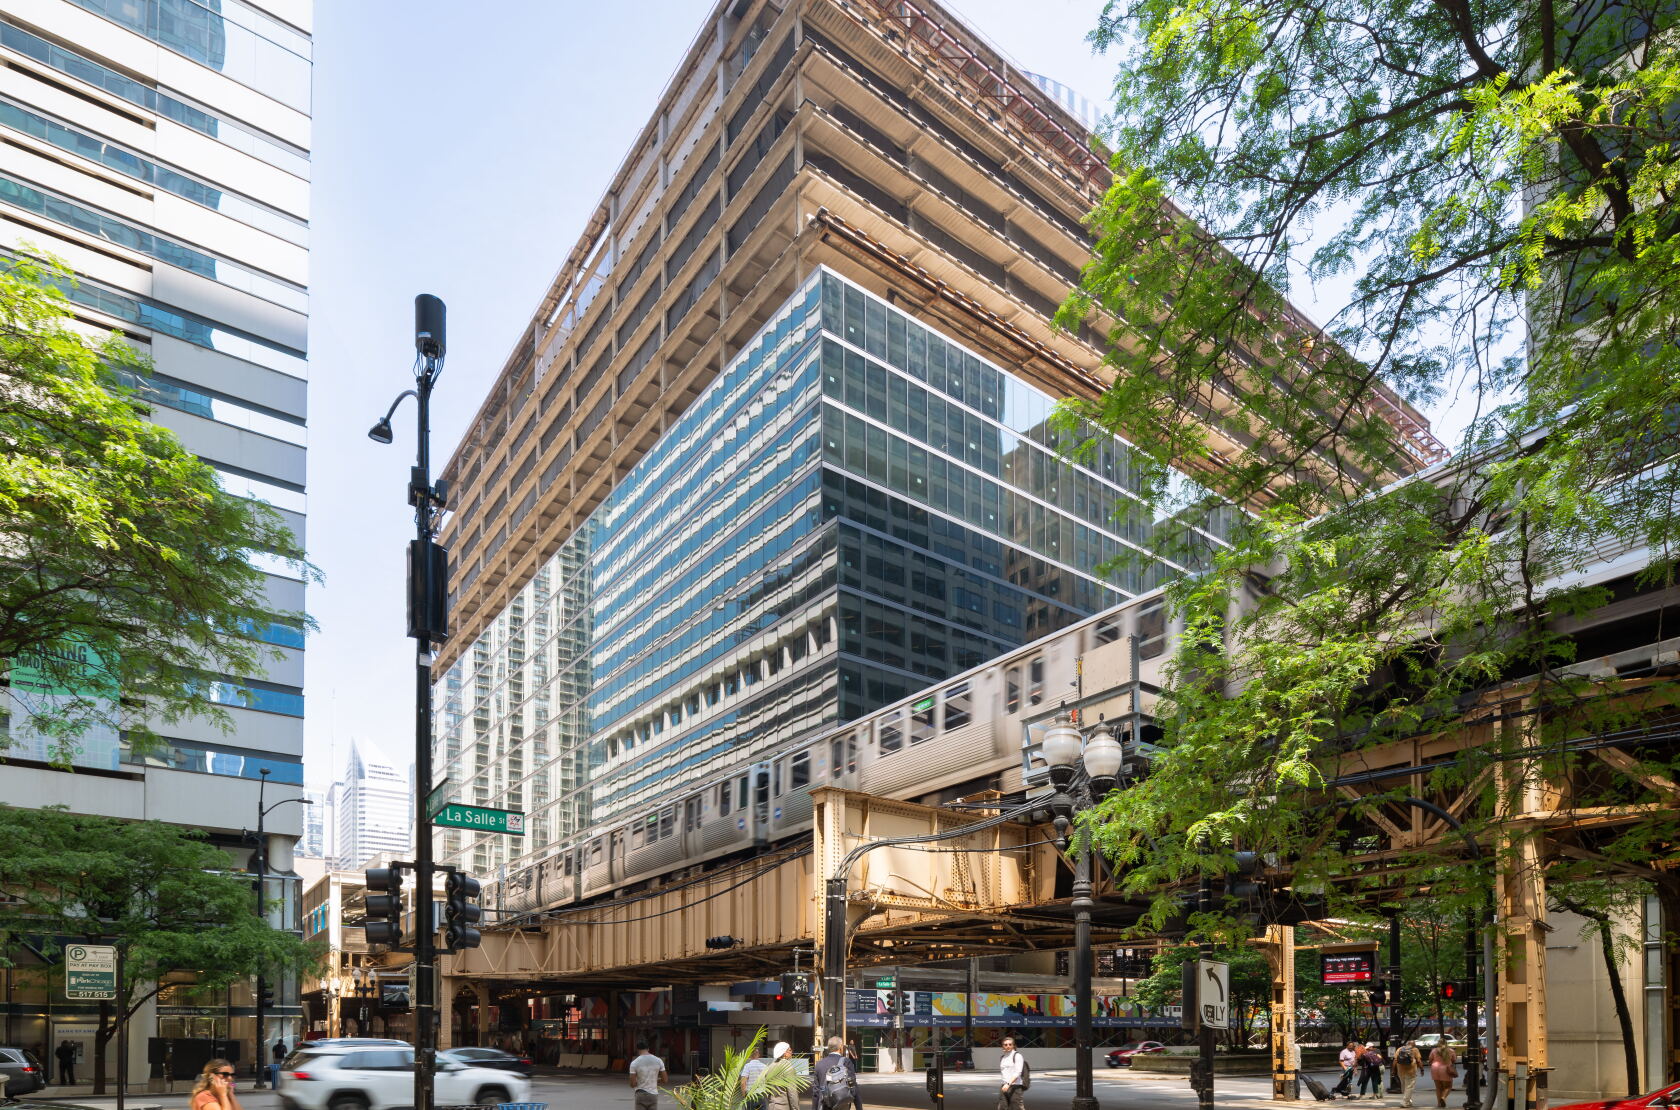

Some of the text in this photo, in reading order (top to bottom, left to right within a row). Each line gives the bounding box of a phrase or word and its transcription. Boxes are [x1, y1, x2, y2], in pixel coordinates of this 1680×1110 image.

[446, 807, 462, 822] La
[465, 810, 496, 826] Salle
[498, 816, 505, 825] St
